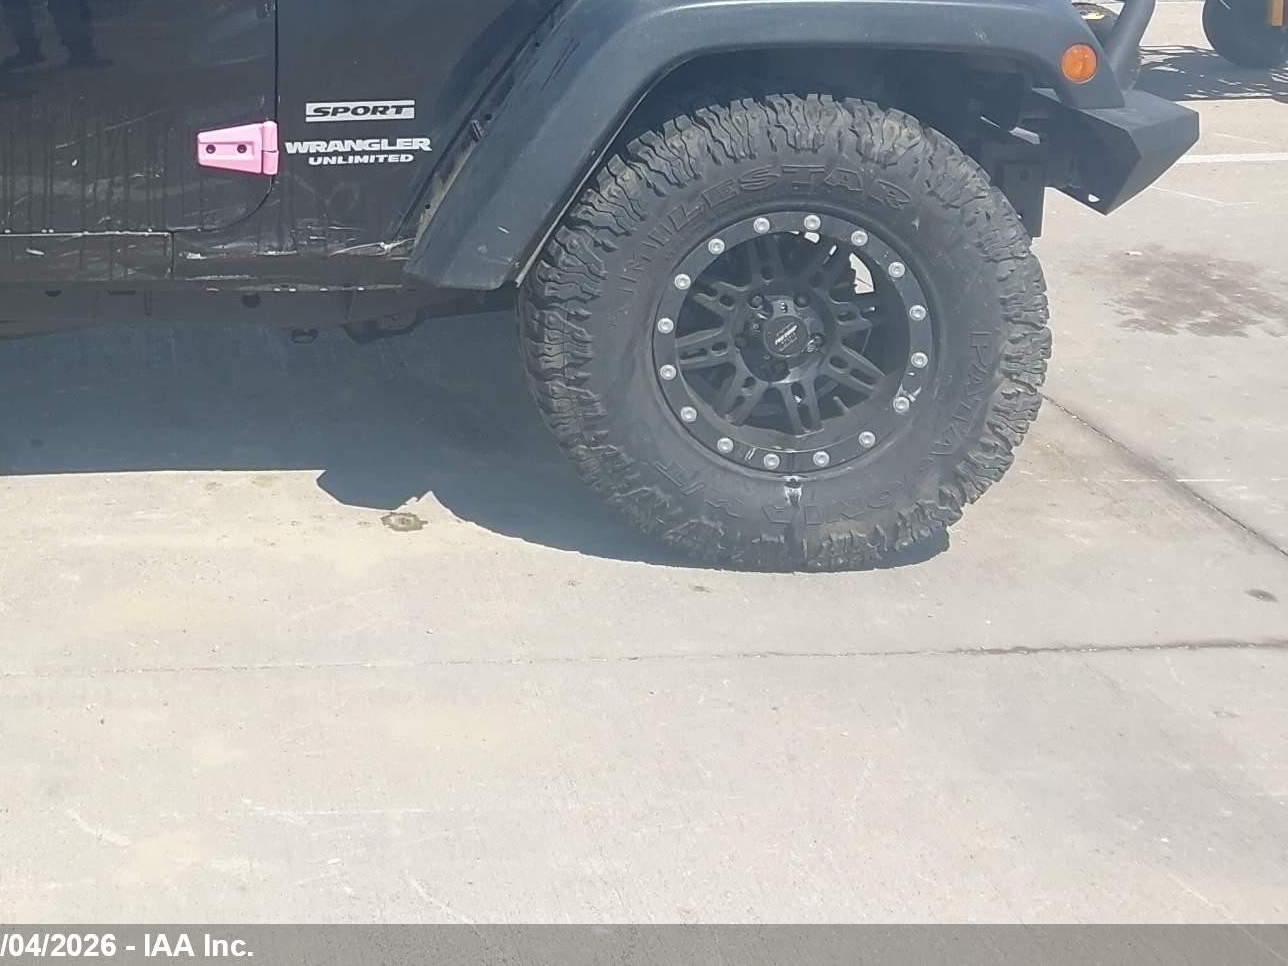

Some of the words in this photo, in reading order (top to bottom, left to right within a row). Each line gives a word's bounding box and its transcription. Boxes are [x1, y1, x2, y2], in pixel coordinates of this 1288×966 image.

[307, 104, 414, 118] SPORT
[284, 137, 433, 154] WRANGLER
[308, 153, 414, 166] UNLIMITED
